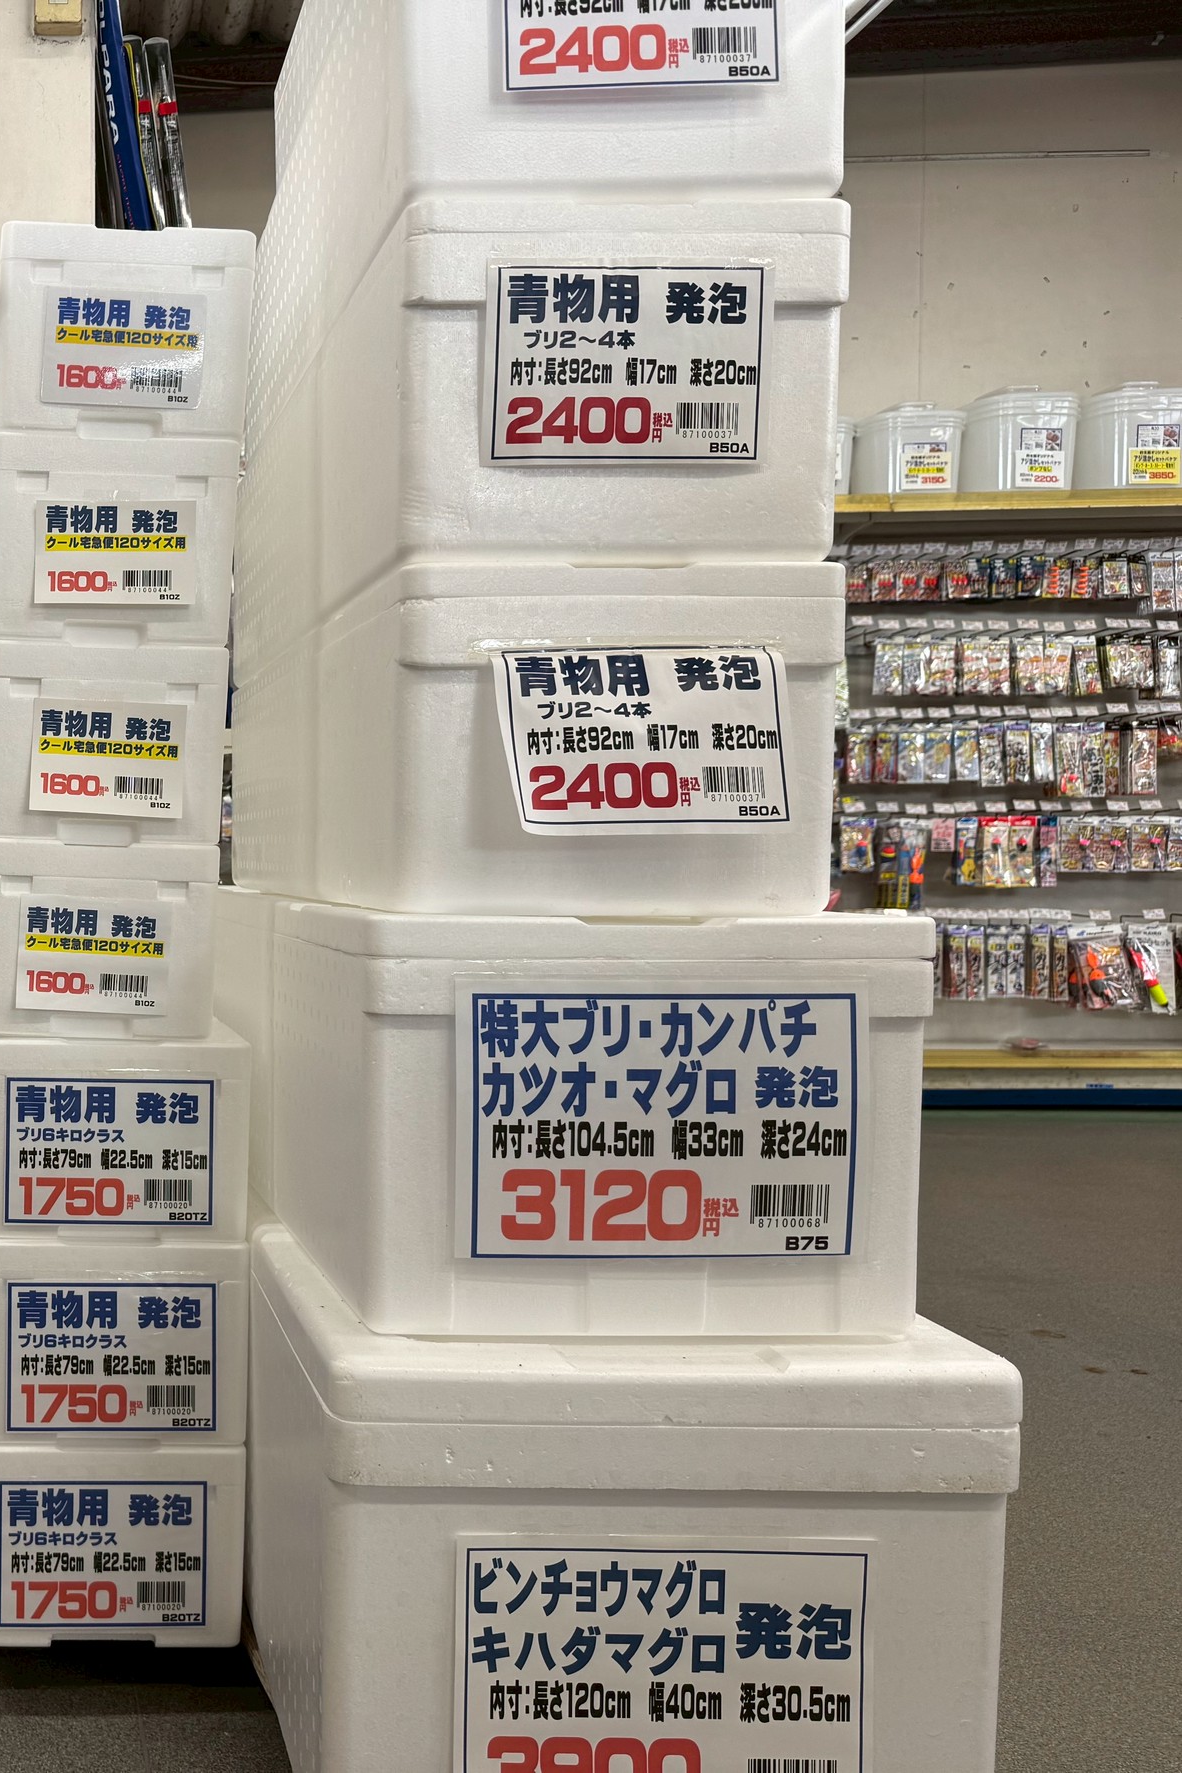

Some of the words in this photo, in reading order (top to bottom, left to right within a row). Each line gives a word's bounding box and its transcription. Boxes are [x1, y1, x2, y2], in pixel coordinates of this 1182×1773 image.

[699, 53, 751, 64] 87100037
[728, 65, 770, 77] B50A
[508, 274, 639, 323] 青物用
[666, 282, 746, 324] 発泡
[58, 297, 131, 328] 青物用
[144, 305, 190, 331] 発泡
[625, 357, 676, 386] 幅17cm
[690, 358, 756, 386] 深さ20cm
[682, 429, 732, 439] 87100037
[710, 442, 749, 453] B50A
[46, 505, 117, 533] 青物用
[132, 510, 177, 533] 発泡
[46, 537, 186, 549] クール宅急便120サイズ用
[514, 654, 650, 697] 青物用
[674, 655, 762, 691] 発泡
[643, 723, 699, 752] 幅17cm
[710, 722, 779, 751] 深さ20cm
[738, 804, 781, 816] B50A
[480, 999, 816, 1058] 特大ブリ・カンパチ
[481, 1060, 736, 1118] カツオ・マグロ
[755, 1065, 839, 1108] 発泡
[672, 1119, 744, 1160] 幅33cm
[760, 1119, 847, 1160] 深さ24cm
[501, 1168, 703, 1241] 3120
[758, 1217, 821, 1228] 87100068
[785, 1236, 829, 1251] B75
[17, 1290, 117, 1328] 青物用
[138, 1296, 200, 1328] 発泡
[18, 1333, 126, 1348] ブリ6キロクラス
[103, 1355, 156, 1377] 幅22.5cm
[164, 1354, 210, 1377] 深さ15cm
[151, 1407, 192, 1415] 87100020
[172, 1418, 211, 1427] B20TZ
[473, 1557, 726, 1619] ビンチョウマグロ
[735, 1602, 852, 1661] 発泡
[471, 1625, 725, 1676] キハダマグロ
[648, 1681, 722, 1722] 幅40cm
[739, 1682, 851, 1724] 深さ30.5cm
